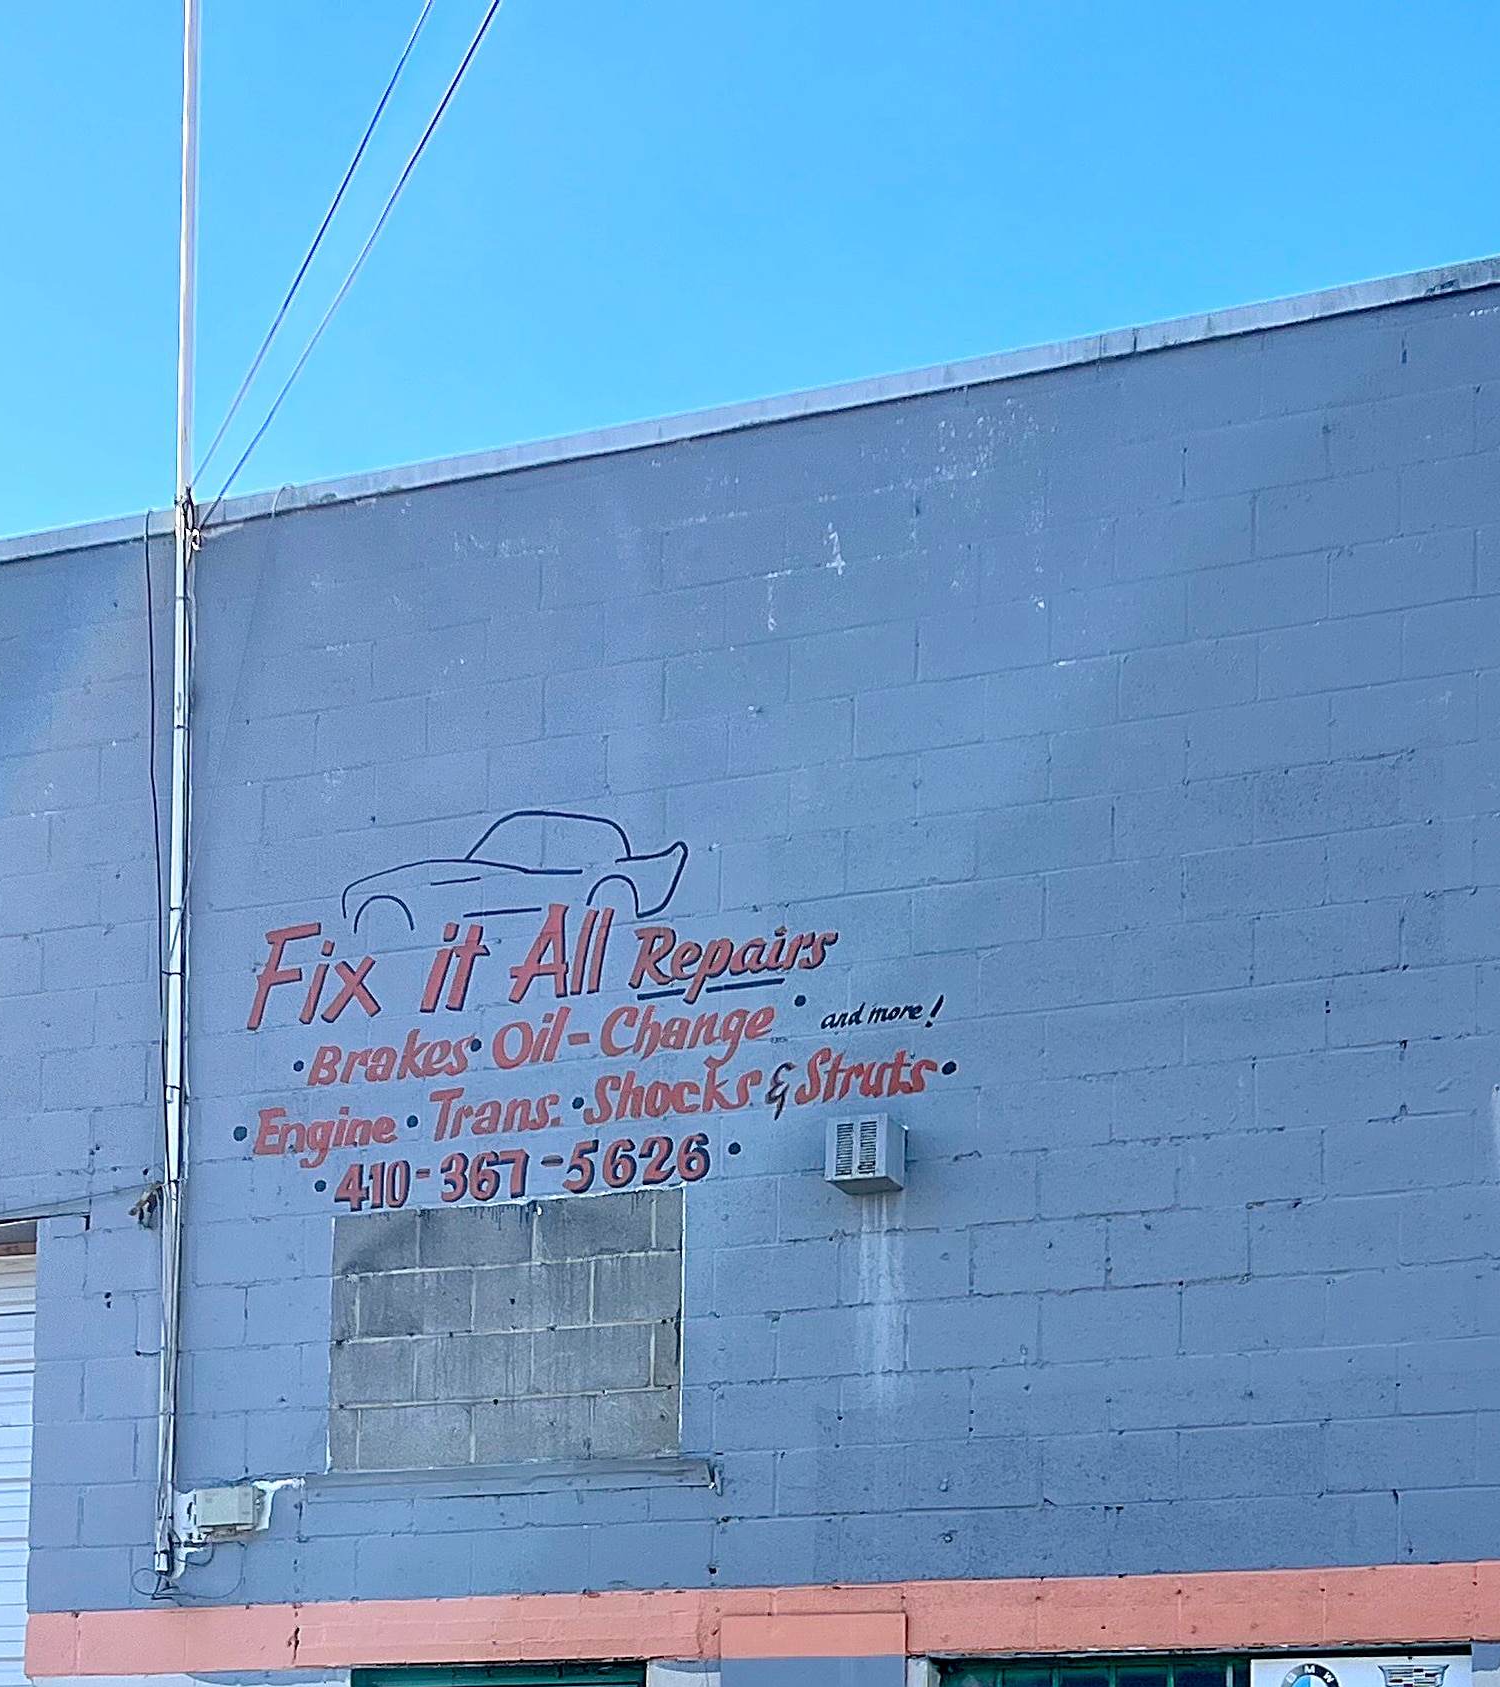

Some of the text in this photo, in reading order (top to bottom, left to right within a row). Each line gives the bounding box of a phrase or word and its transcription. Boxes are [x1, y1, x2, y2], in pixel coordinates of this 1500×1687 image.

[246, 903, 839, 1031] Fix it All Repairs
[306, 1028, 476, 1087] Brakes
[820, 1002, 866, 1031] and
[252, 1047, 939, 1169] Engine Trans. Shocks & Struts
